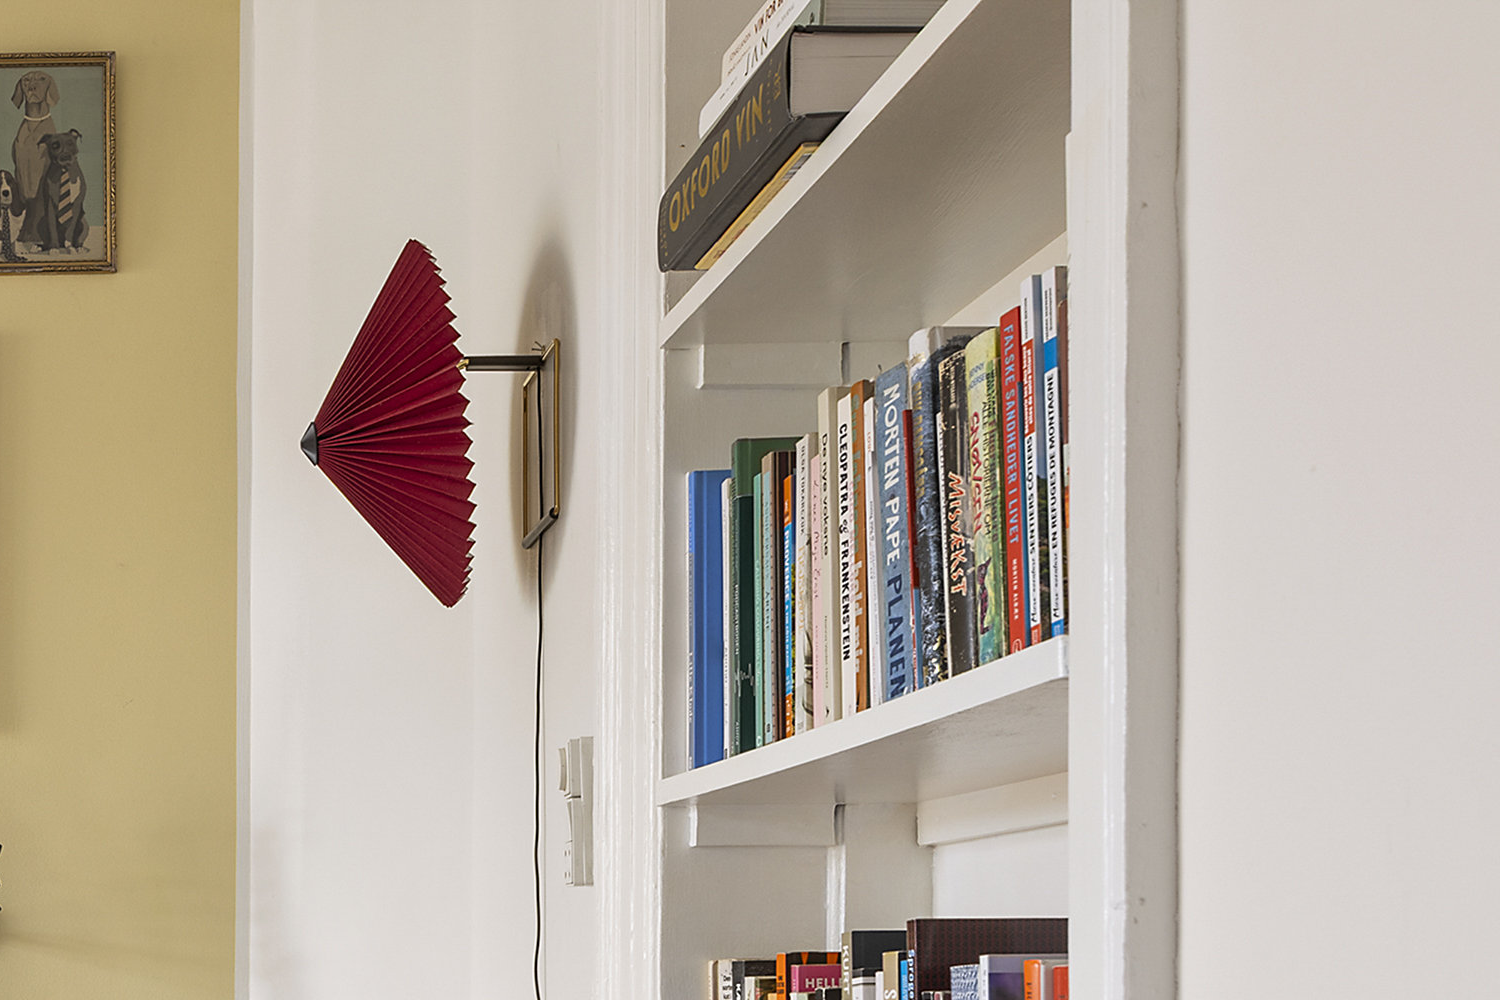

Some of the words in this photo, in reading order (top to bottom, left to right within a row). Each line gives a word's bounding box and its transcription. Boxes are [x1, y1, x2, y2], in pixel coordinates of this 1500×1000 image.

[668, 128, 731, 232] OXFORD
[736, 82, 764, 151] VIN
[1004, 324, 1015, 386] FALSKE
[822, 433, 828, 458] De
[883, 383, 901, 491] MORTEN
[1005, 388, 1018, 484] SANDHEDER
[1046, 373, 1056, 449] MONTAGNE
[839, 423, 849, 516] CLEOPATRA
[1048, 452, 1055, 470] DE
[885, 496, 901, 567] PAPE
[948, 471, 968, 597] MISVÆKST
[1009, 498, 1019, 544] LIVET
[1028, 493, 1036, 554] SENTIERS
[1049, 472, 1057, 529] REFUGES
[1051, 531, 1058, 550] EN
[840, 539, 851, 661] FRANKENSTEIN
[887, 574, 906, 699] PLANEN
[842, 944, 851, 995] KURT
